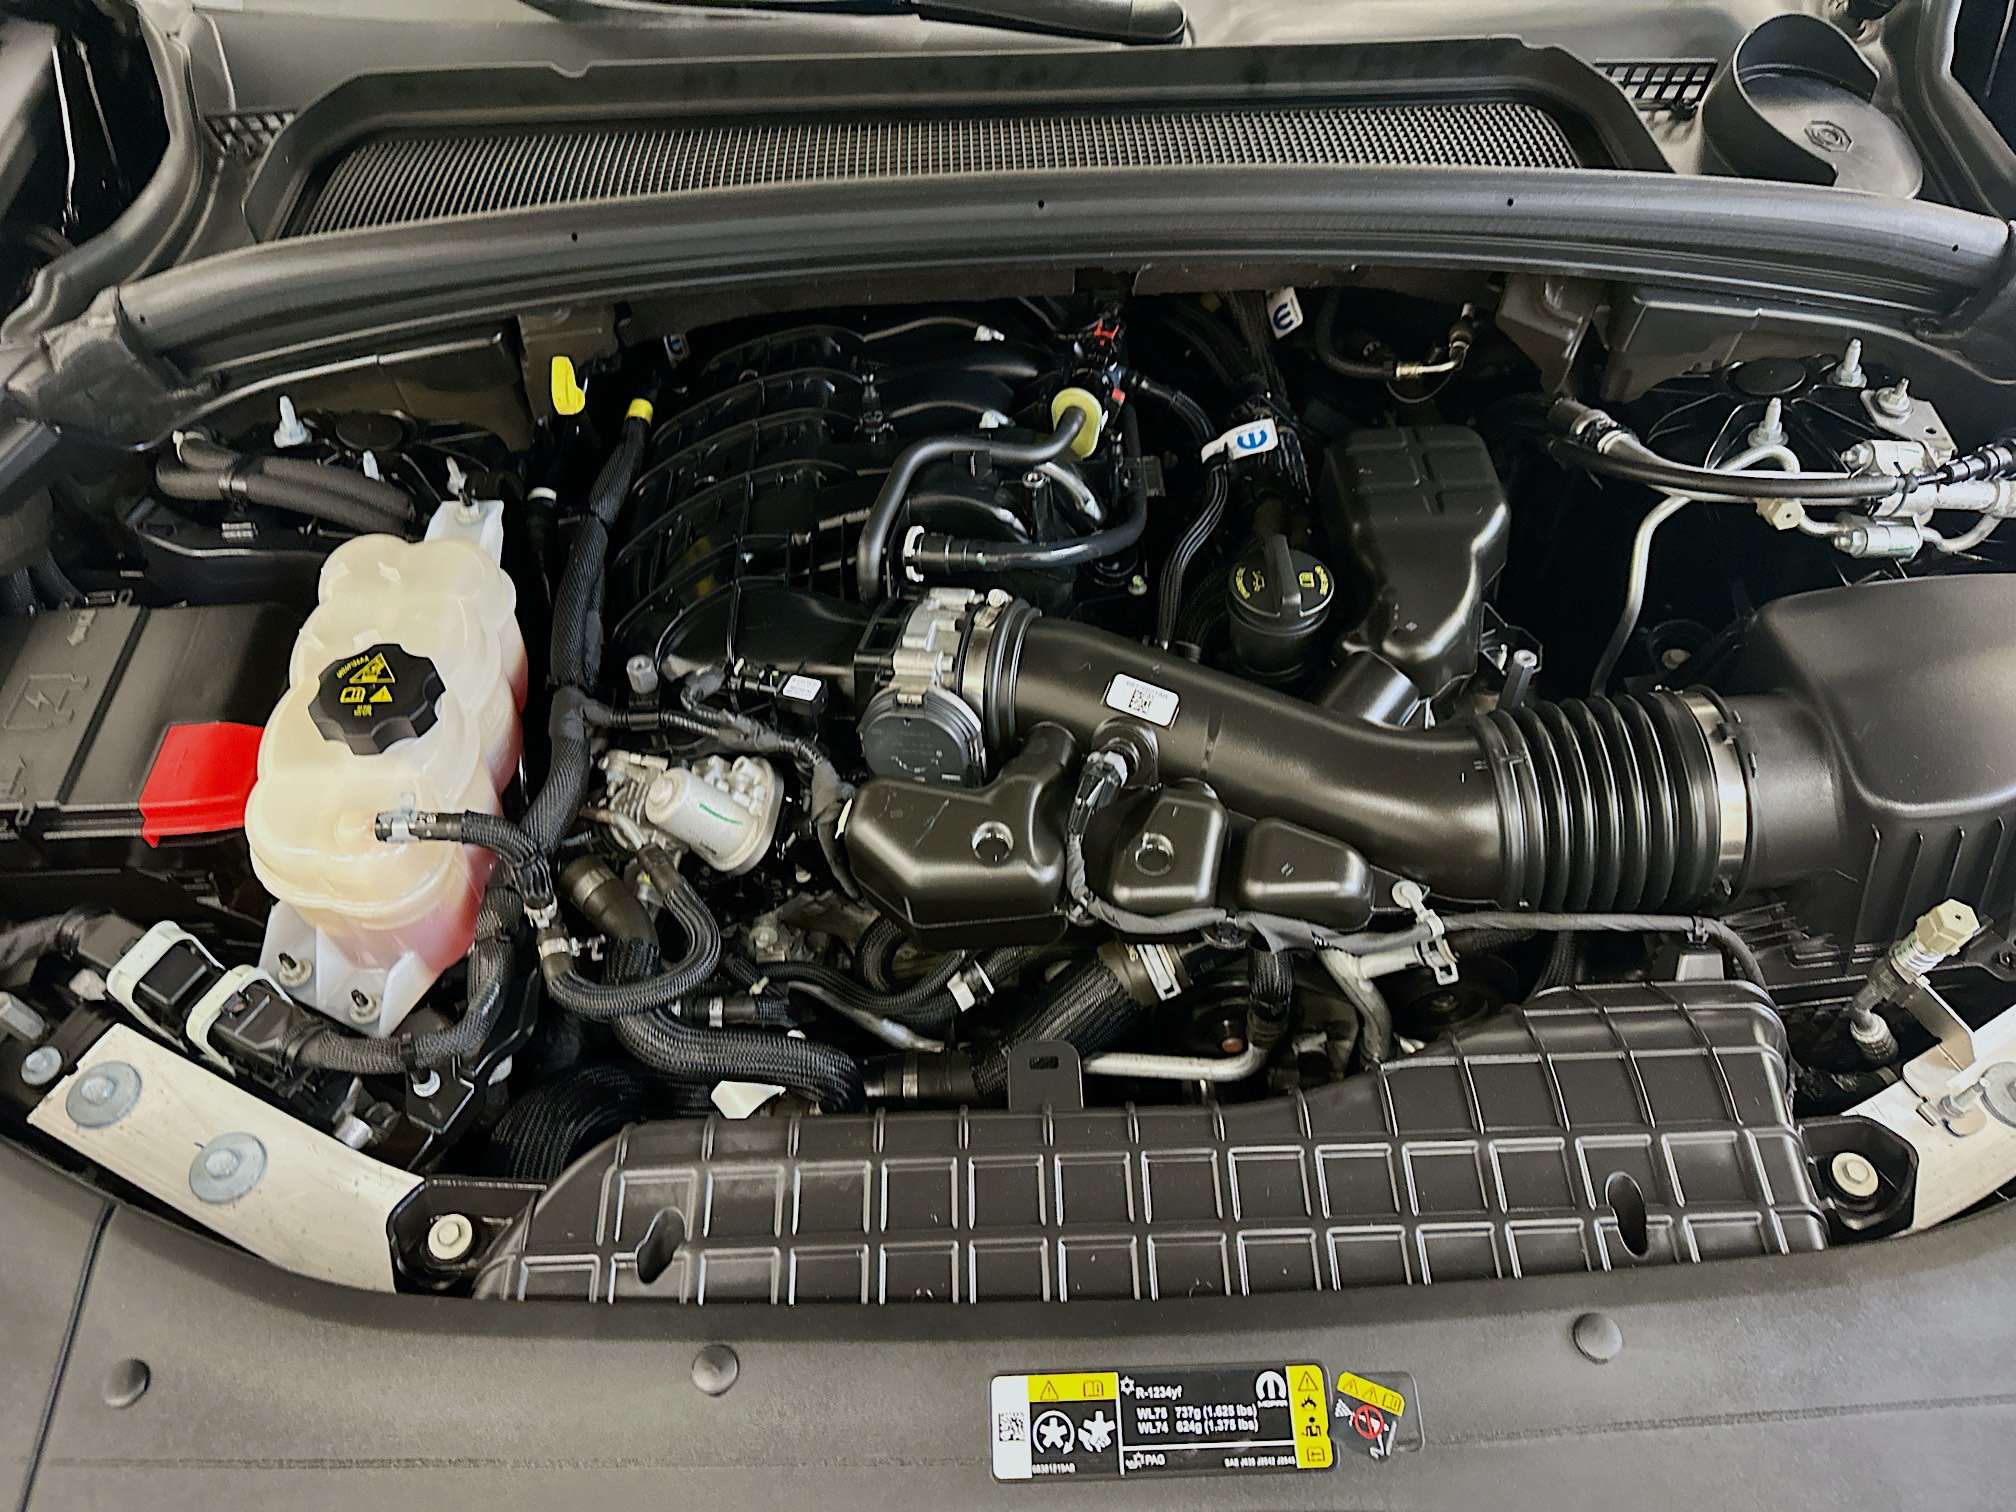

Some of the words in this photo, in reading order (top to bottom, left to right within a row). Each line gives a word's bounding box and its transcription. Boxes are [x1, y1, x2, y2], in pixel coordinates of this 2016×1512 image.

[1135, 1385, 1183, 1400] R-1234yf
[1174, 1405, 1201, 1421] 737g
[1137, 1420, 1169, 1434] WL74
